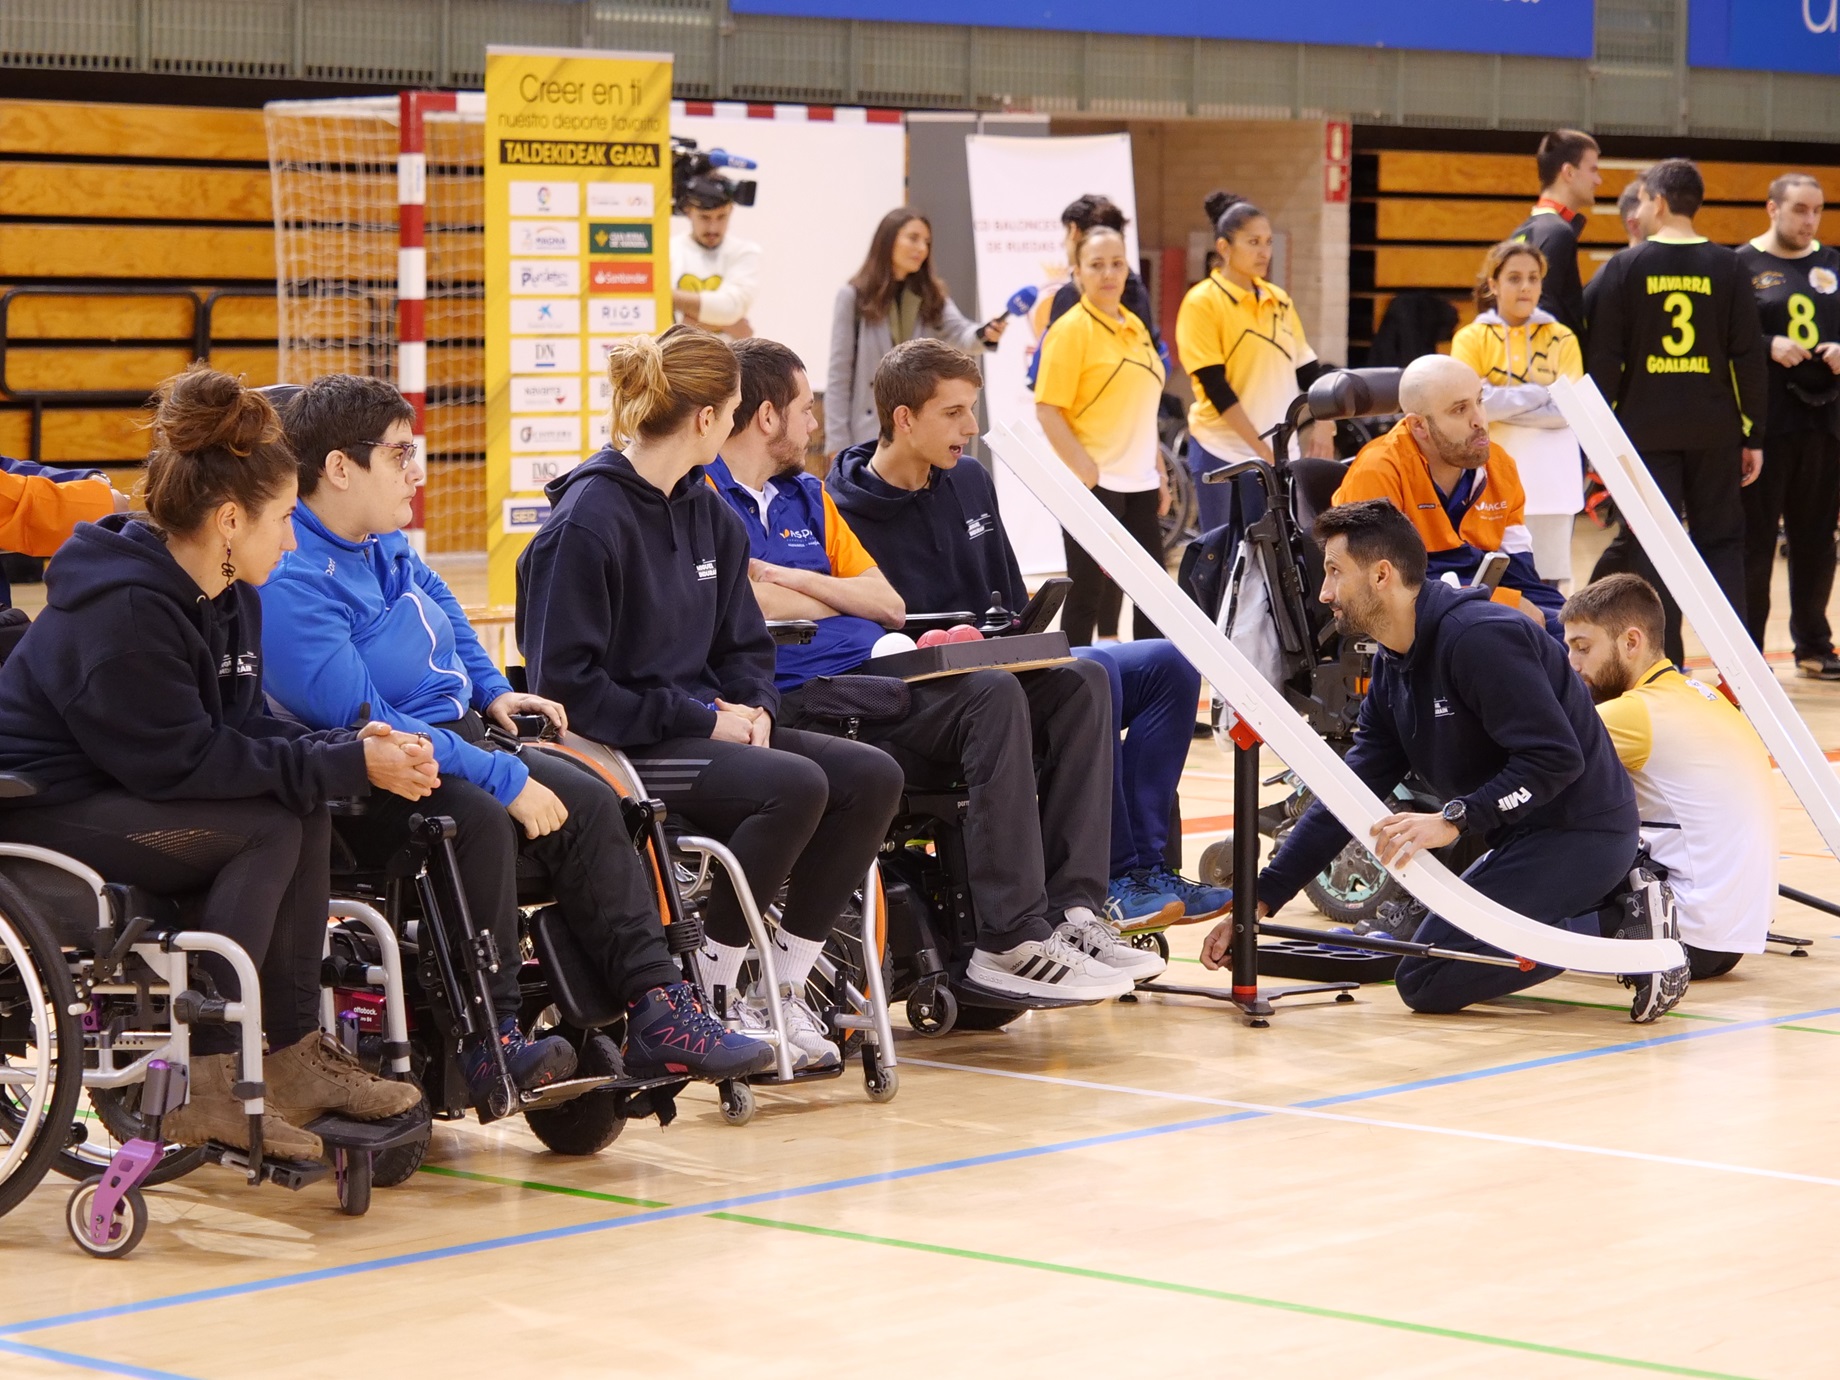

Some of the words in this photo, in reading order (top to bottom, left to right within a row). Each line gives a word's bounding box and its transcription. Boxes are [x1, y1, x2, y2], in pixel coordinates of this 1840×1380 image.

[519, 74, 584, 105] Creer
[592, 82, 623, 106] en
[630, 79, 642, 106] ti
[498, 113, 549, 129] nuestro
[552, 114, 607, 131] deporte
[611, 114, 661, 133] favorito
[504, 141, 607, 165] TALDEKIDEAK
[609, 144, 657, 166] GARA
[605, 272, 649, 285] Santander
[1646, 275, 1712, 297] NAVARRA
[1661, 291, 1696, 357] 3
[1787, 292, 1820, 351] 8
[1646, 353, 1711, 374] GOALBALL
